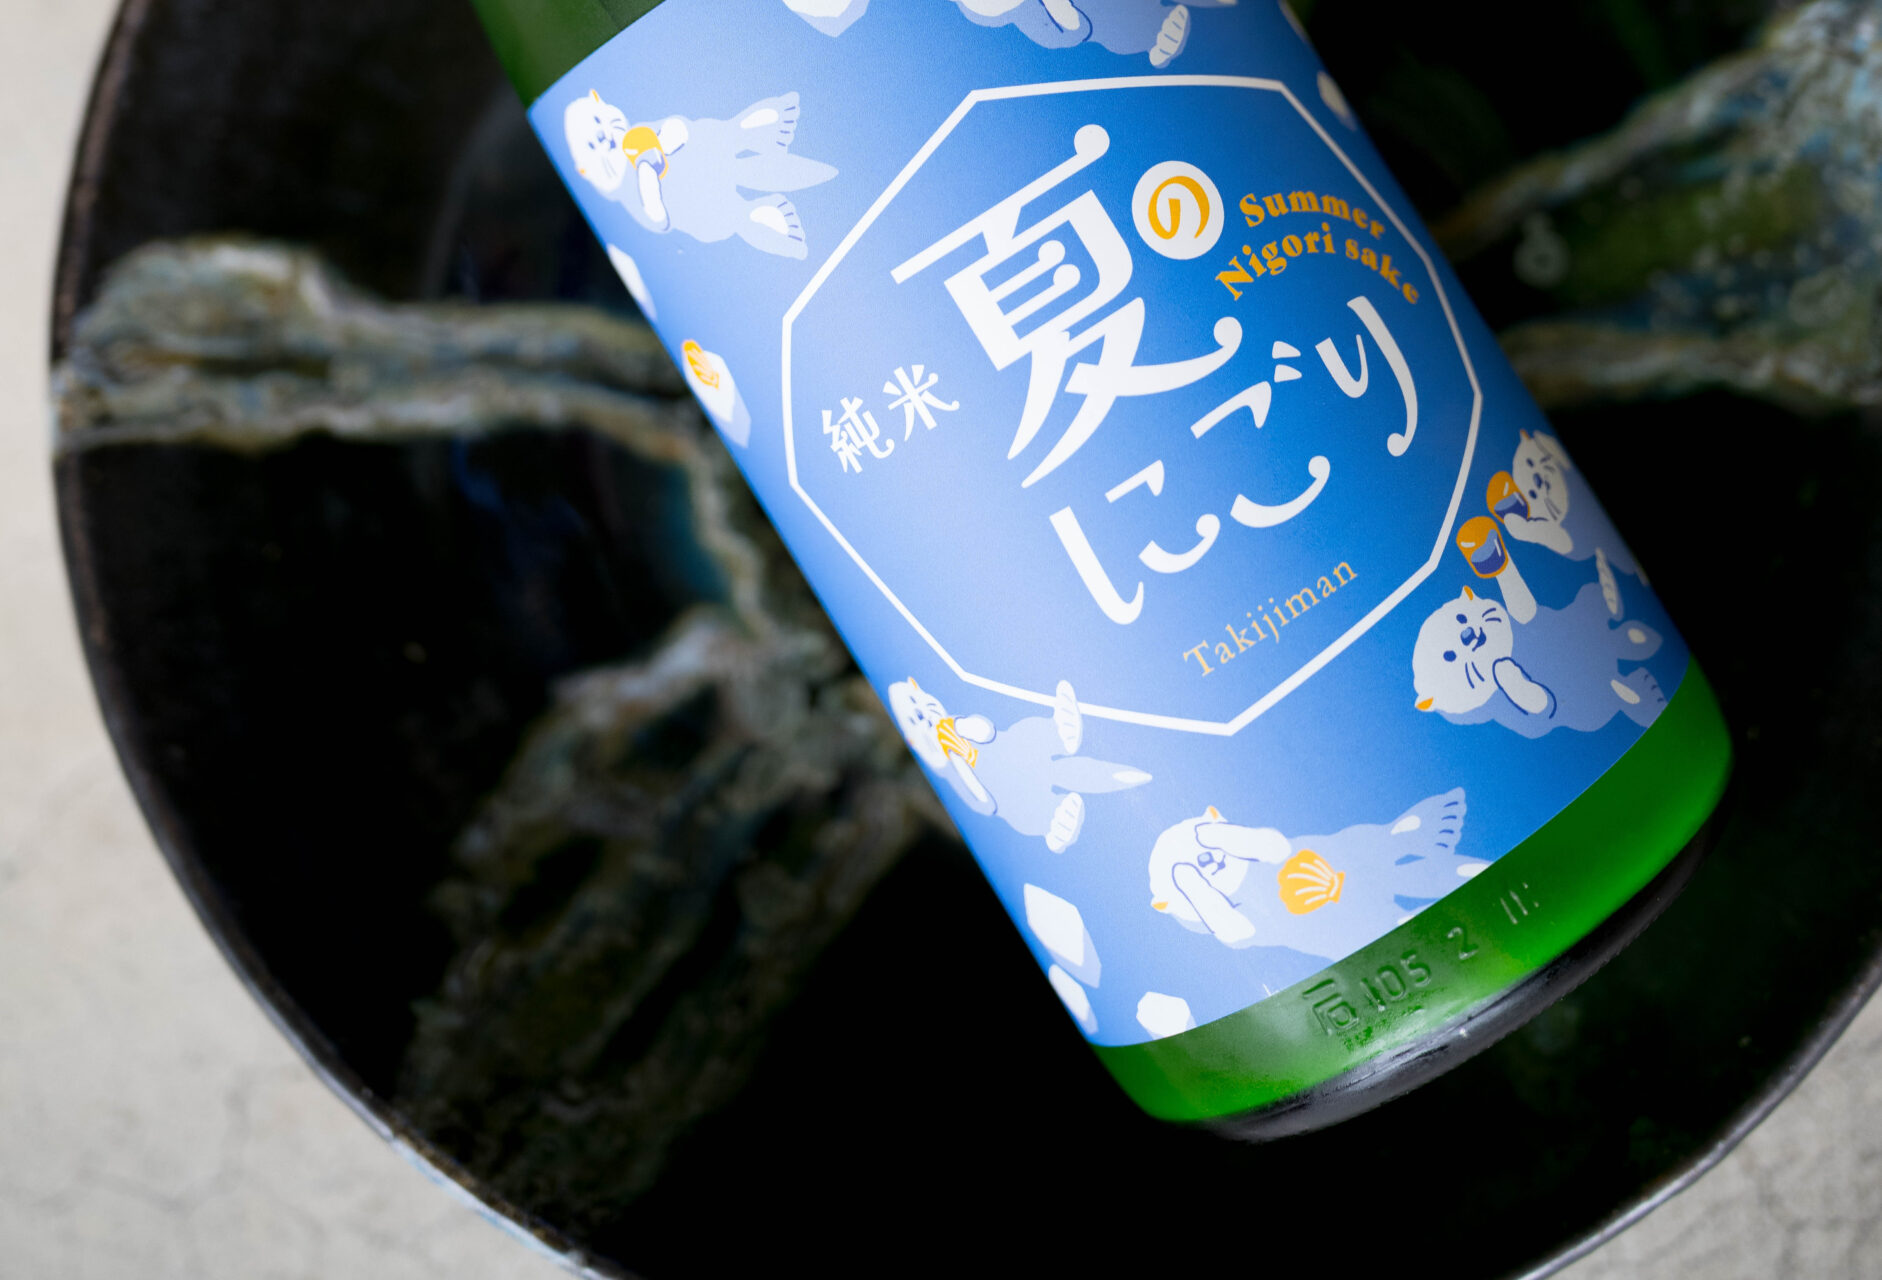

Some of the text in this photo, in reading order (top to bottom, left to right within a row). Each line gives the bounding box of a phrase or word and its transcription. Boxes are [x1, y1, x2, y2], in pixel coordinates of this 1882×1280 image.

[1215, 223, 1419, 304] Nigori sake
[1239, 191, 1386, 239] Summer
[821, 363, 960, 474] 純米
[1048, 296, 1418, 625] にごり
[1182, 560, 1358, 678] Takijiman
